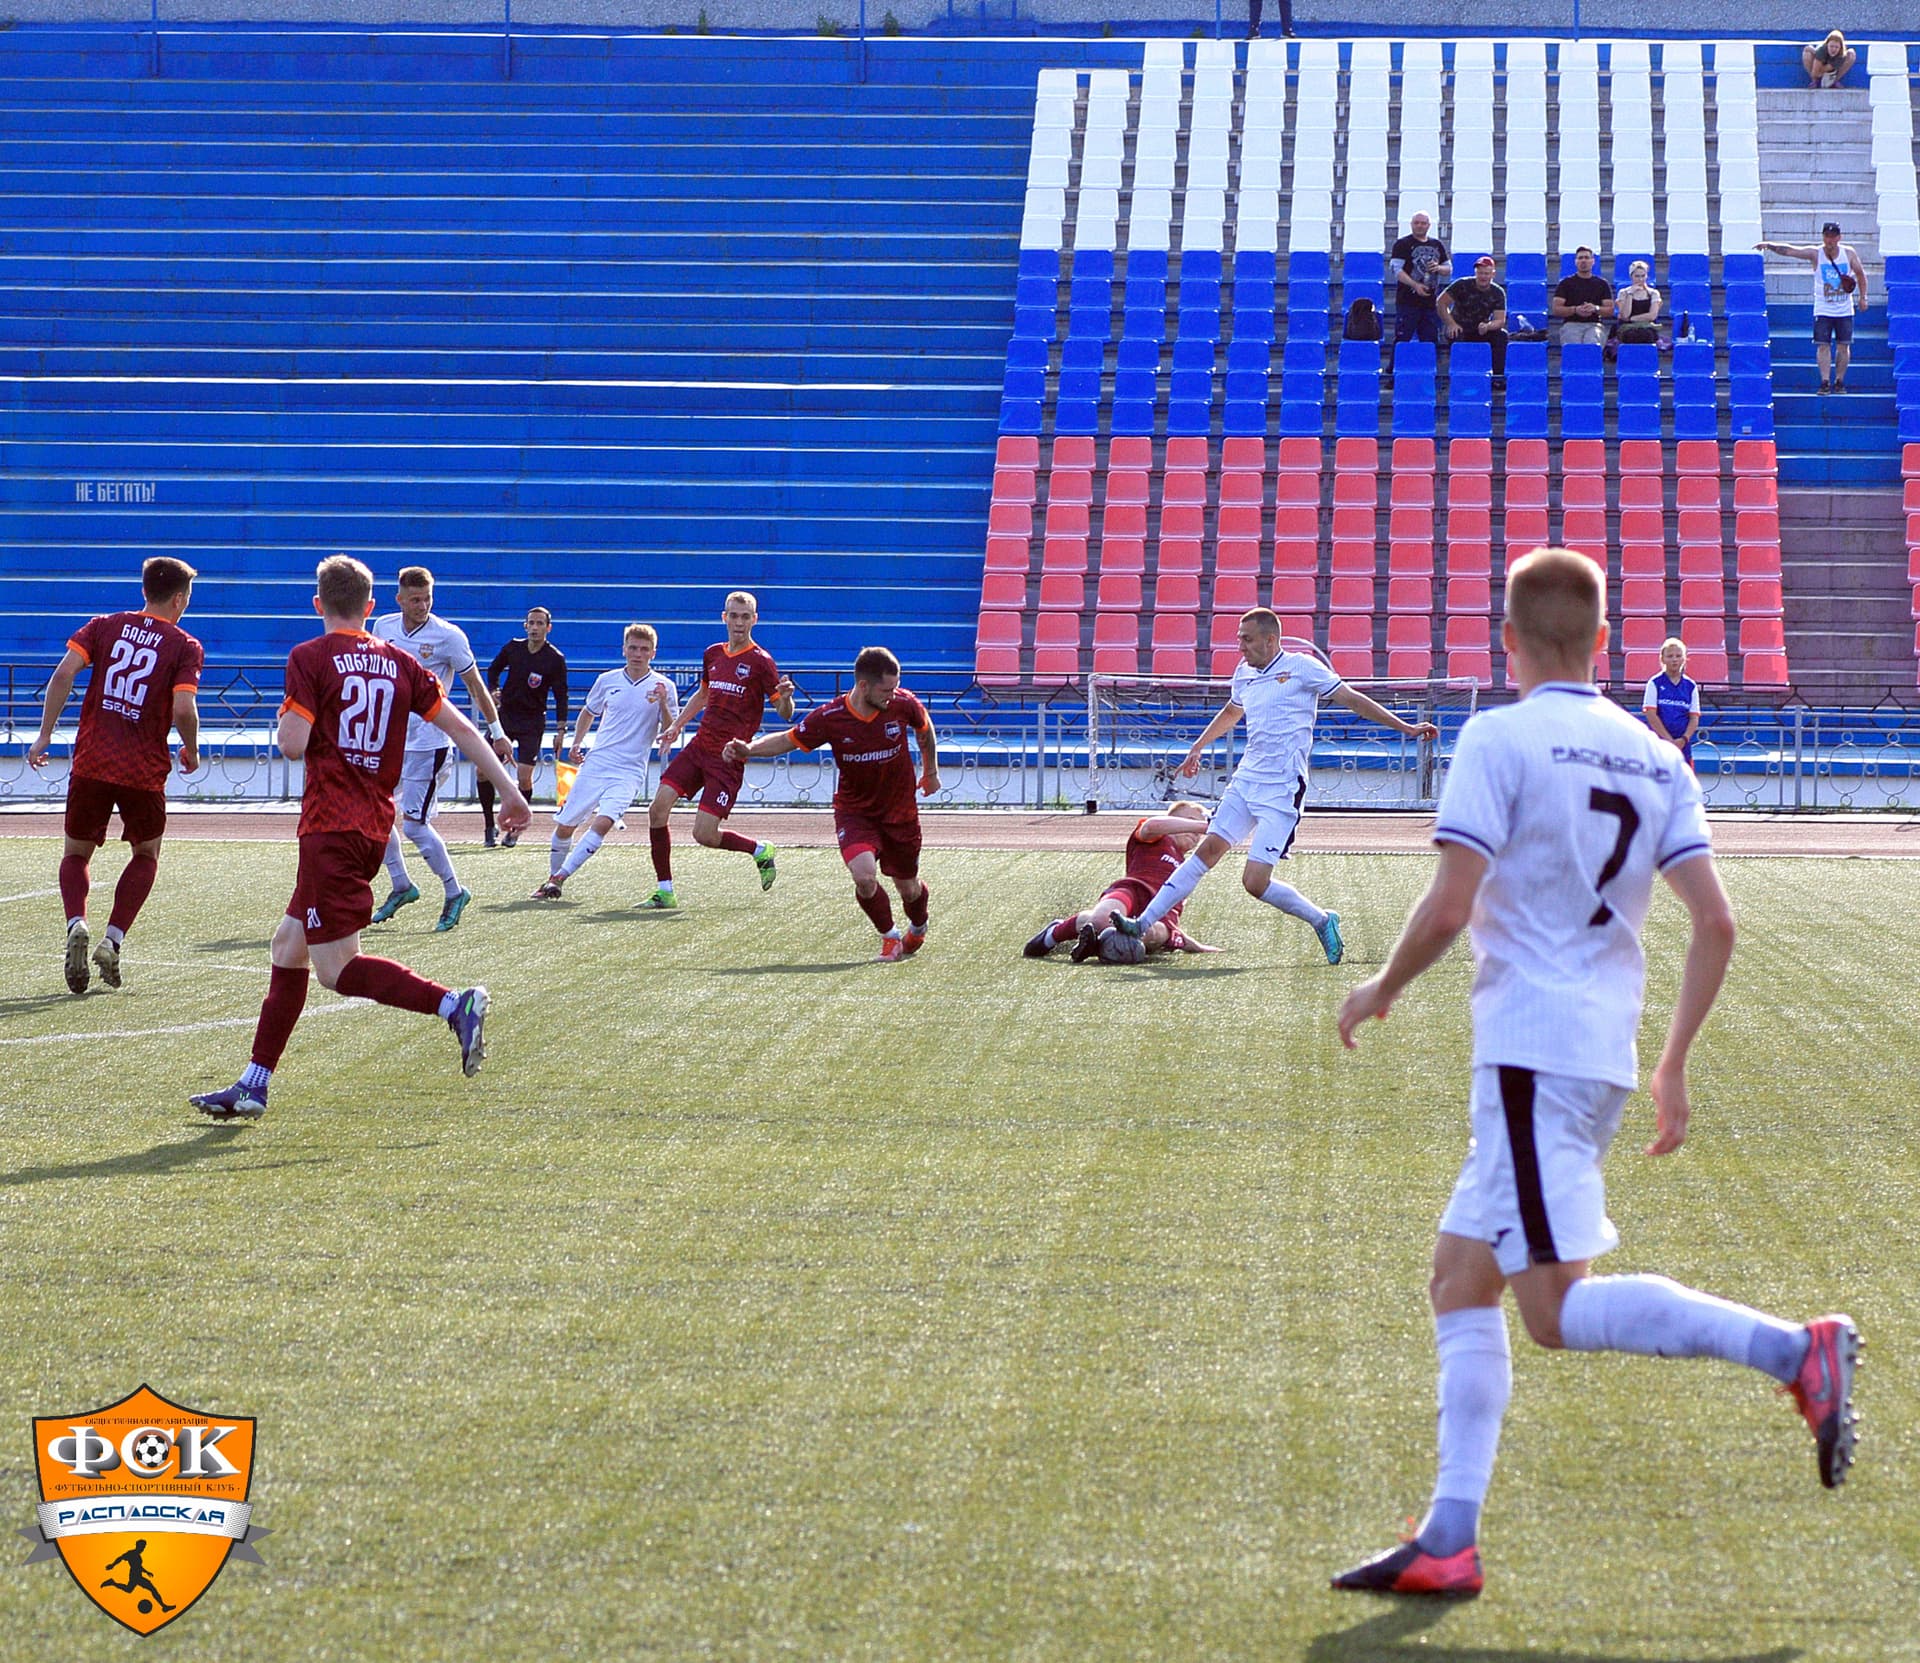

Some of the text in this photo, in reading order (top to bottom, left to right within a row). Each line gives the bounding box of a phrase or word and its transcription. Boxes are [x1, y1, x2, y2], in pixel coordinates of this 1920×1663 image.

[76, 482, 156, 502] НЕ БЕГАТЬ!
[121, 623, 163, 648] БАБИЧ
[103, 639, 158, 706] 22
[102, 698, 141, 720] SELS
[338, 675, 395, 752] 20
[842, 743, 902, 763] ПРОДИНВЕСТ
[716, 791, 729, 807] 33
[1587, 786, 1641, 927] 7
